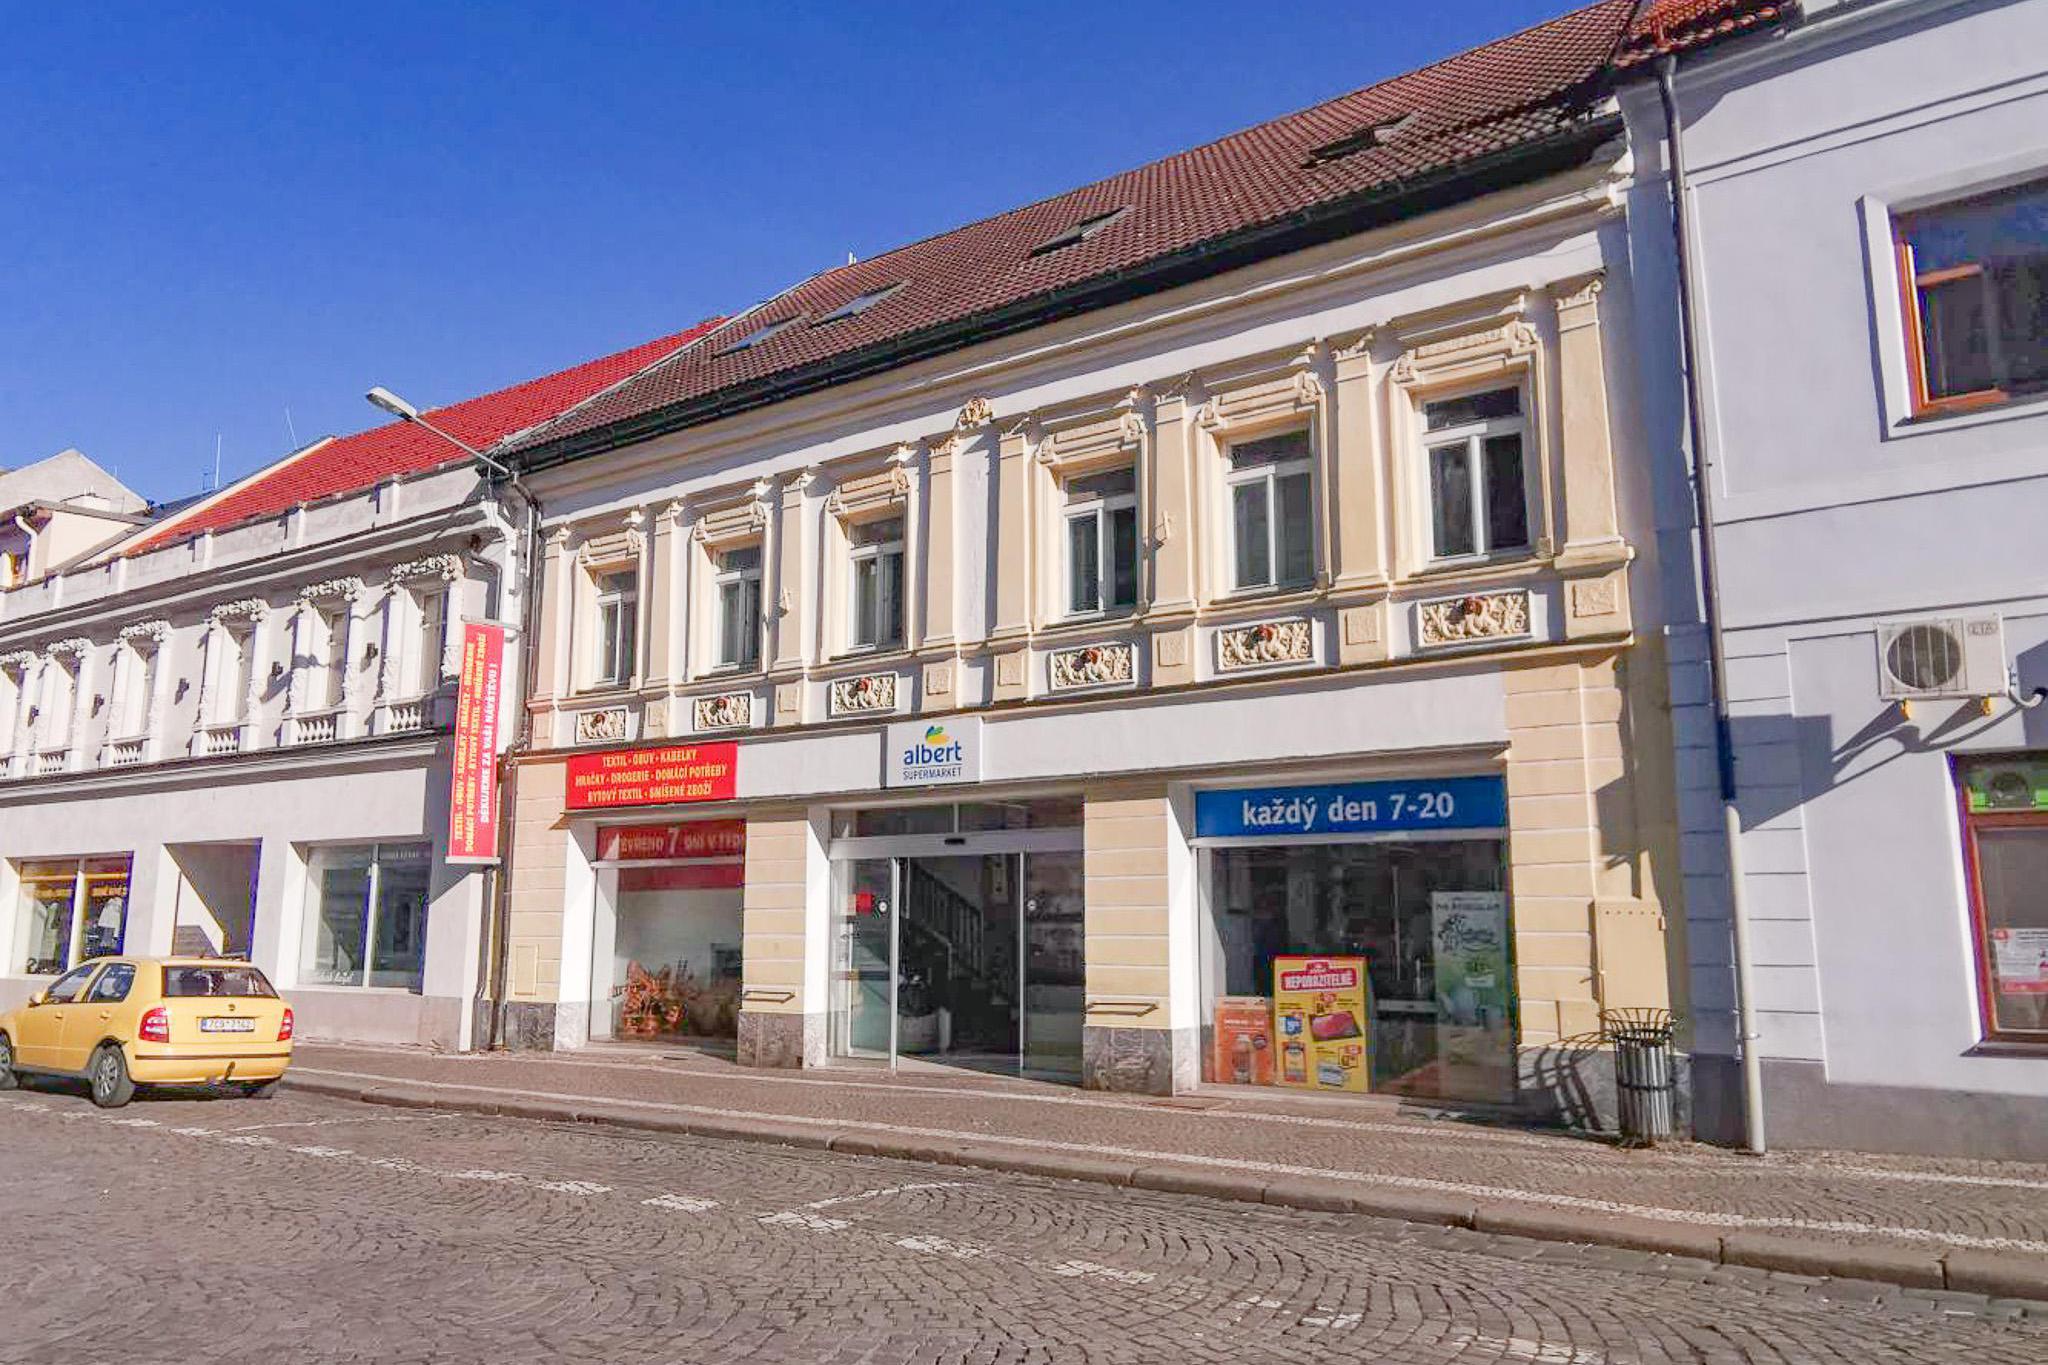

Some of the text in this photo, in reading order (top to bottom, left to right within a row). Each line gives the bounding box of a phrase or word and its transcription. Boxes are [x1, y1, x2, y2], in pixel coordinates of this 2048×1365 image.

[471, 706, 481, 733] TEXTIL
[457, 734, 468, 773] KABELKY
[481, 752, 491, 766] ZA
[602, 749, 697, 768] TEXTIL OBUV KABELKY
[903, 740, 962, 766] albert
[575, 772, 605, 787] HRAČKY
[611, 770, 650, 784] DROGERIE
[689, 762, 727, 778] POTŘEBY
[903, 767, 962, 780] SUPERMARKET
[455, 779, 465, 805] OBUV
[587, 787, 617, 803] BYTOVÝ
[618, 787, 643, 802] TEXTIL
[1242, 791, 1455, 831] každý den 7-20
[454, 811, 464, 840] TEXTIL
[667, 827, 680, 855] 7
